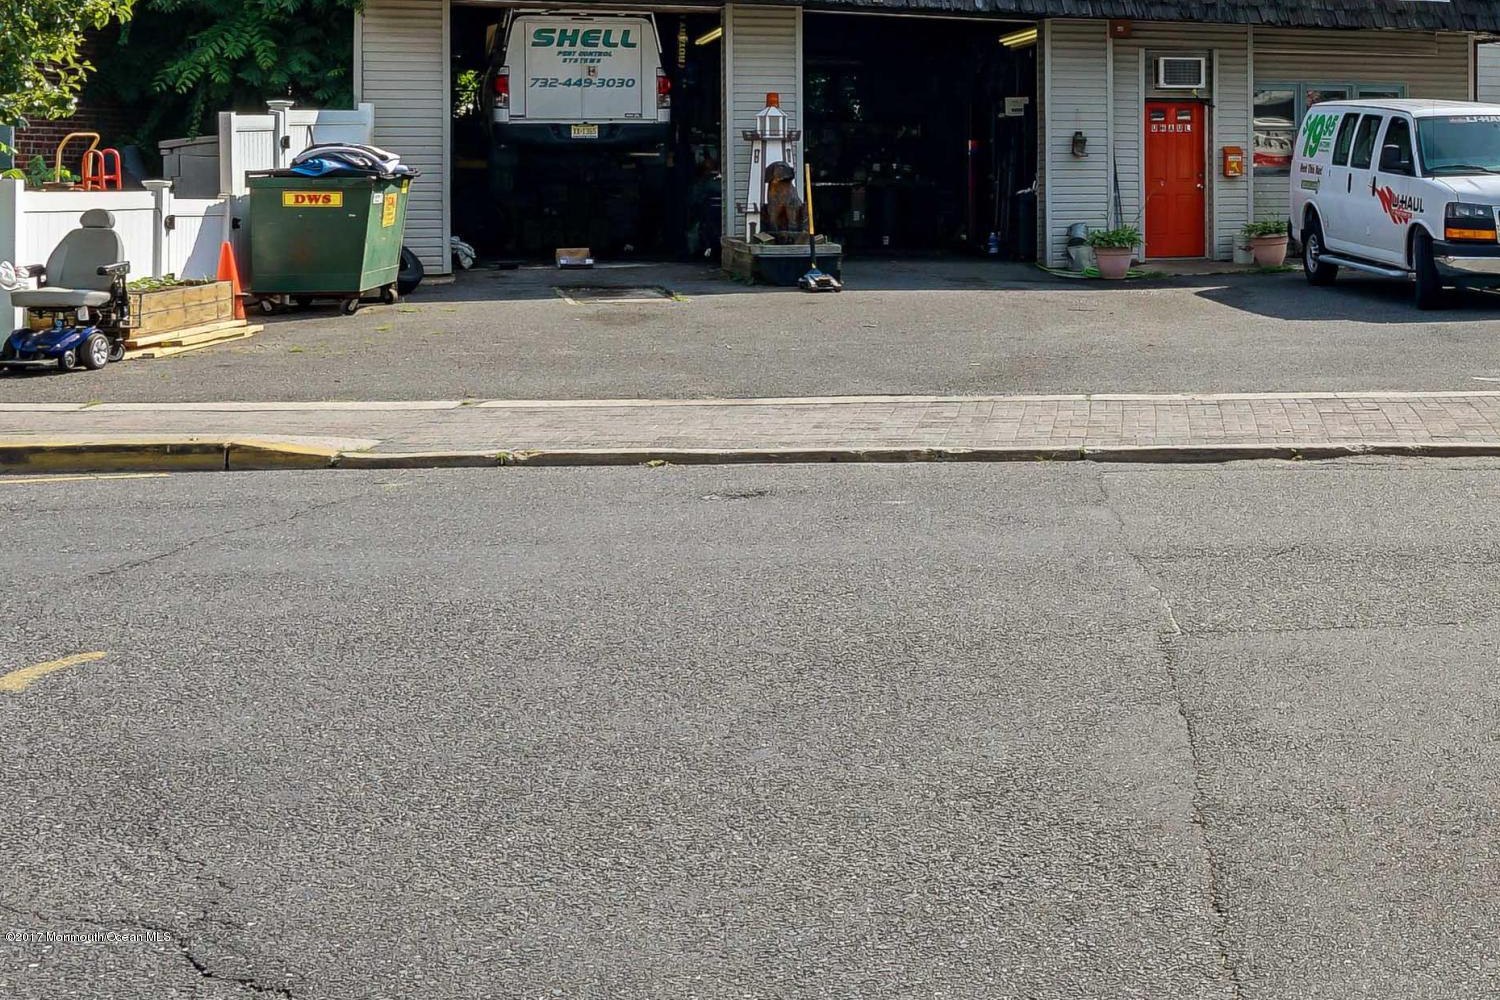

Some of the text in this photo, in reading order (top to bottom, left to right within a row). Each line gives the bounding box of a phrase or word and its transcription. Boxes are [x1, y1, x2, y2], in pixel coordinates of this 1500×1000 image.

[531, 28, 637, 48] SHELL
[529, 78, 636, 88] 732-449-3030
[294, 194, 331, 204] DWS
[1392, 193, 1424, 213] U-HAUL
